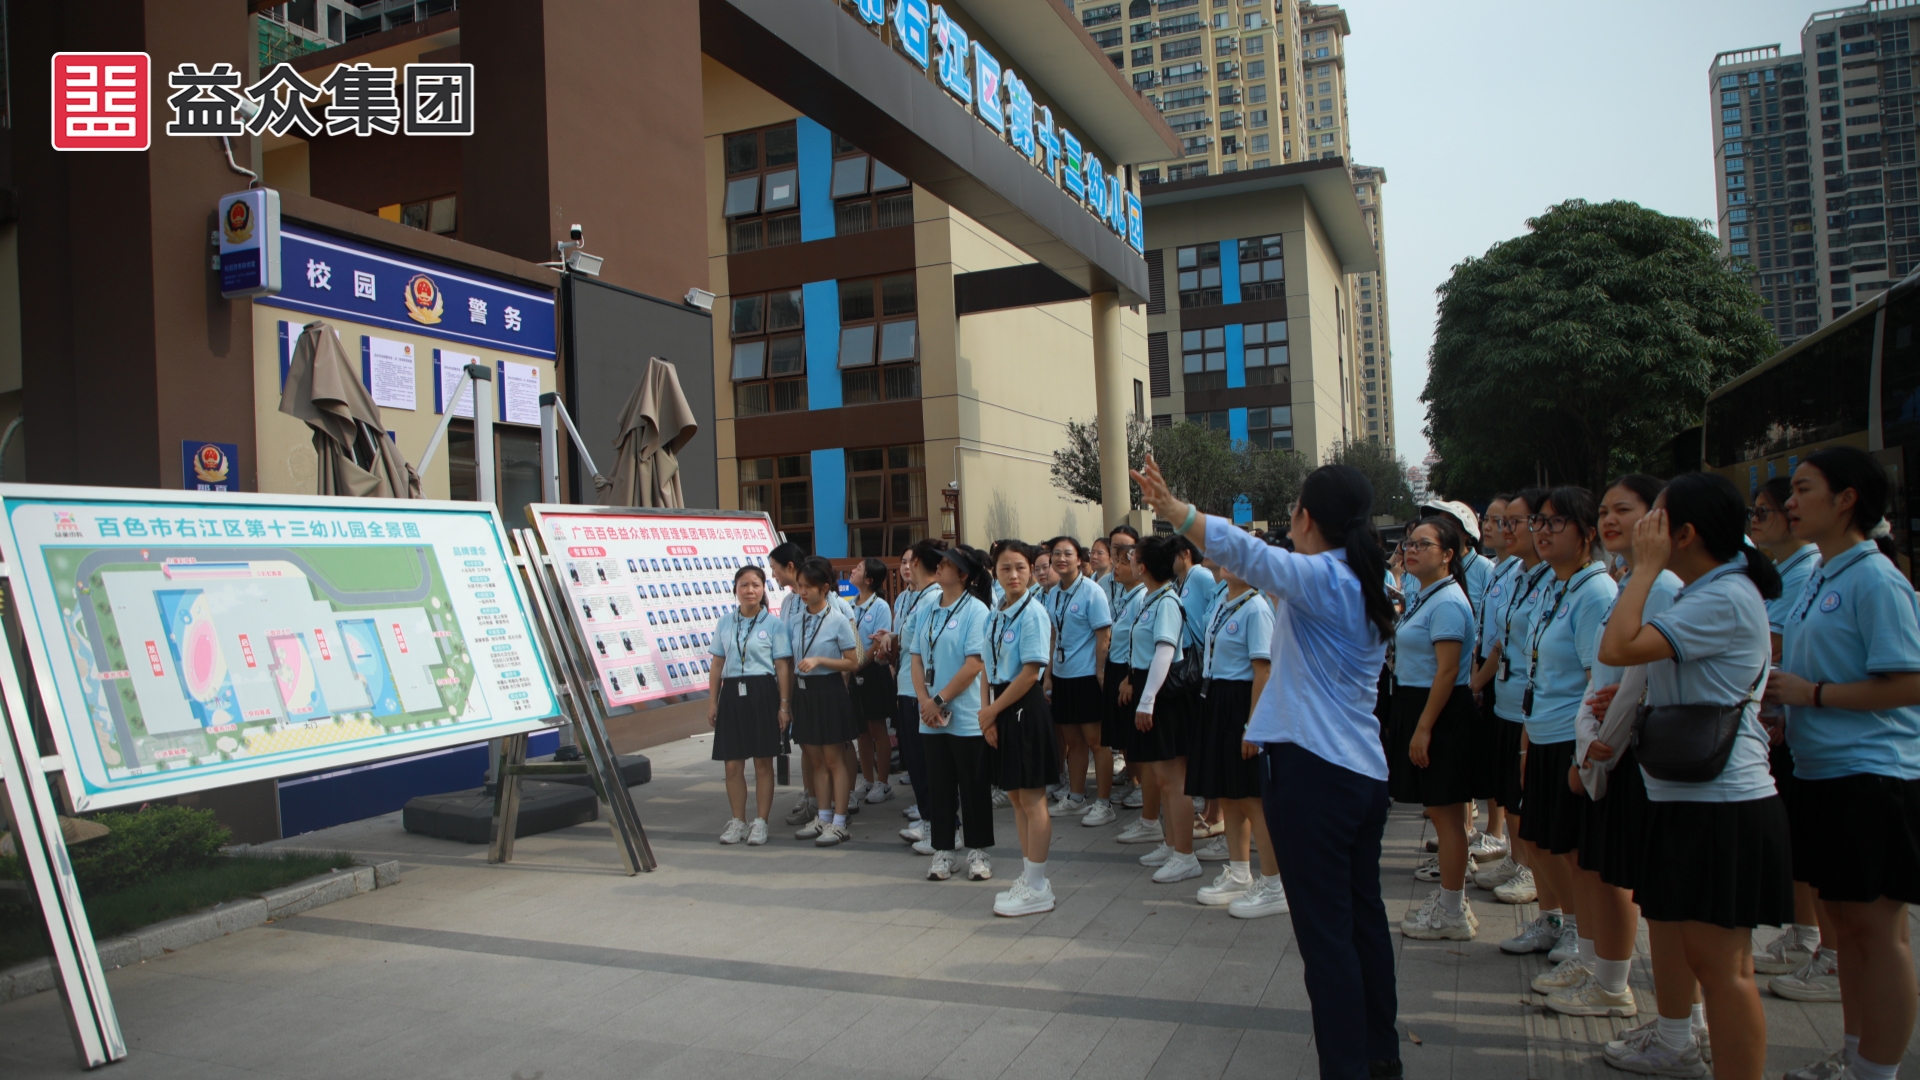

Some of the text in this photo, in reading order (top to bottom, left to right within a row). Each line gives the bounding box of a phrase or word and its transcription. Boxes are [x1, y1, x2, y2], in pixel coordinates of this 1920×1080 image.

[306, 258, 522, 332] 校园 警务
[94, 516, 421, 539] 百色市右江区第十三幼儿园全景图
[572, 526, 767, 540] 广西百色益众教育管理集团有限公司师资队伍
[453, 546, 487, 556] 品牌理念
[573, 547, 602, 556] 专家团队
[148, 645, 162, 672] 发现楼
[304, 722, 318, 730] 大门
